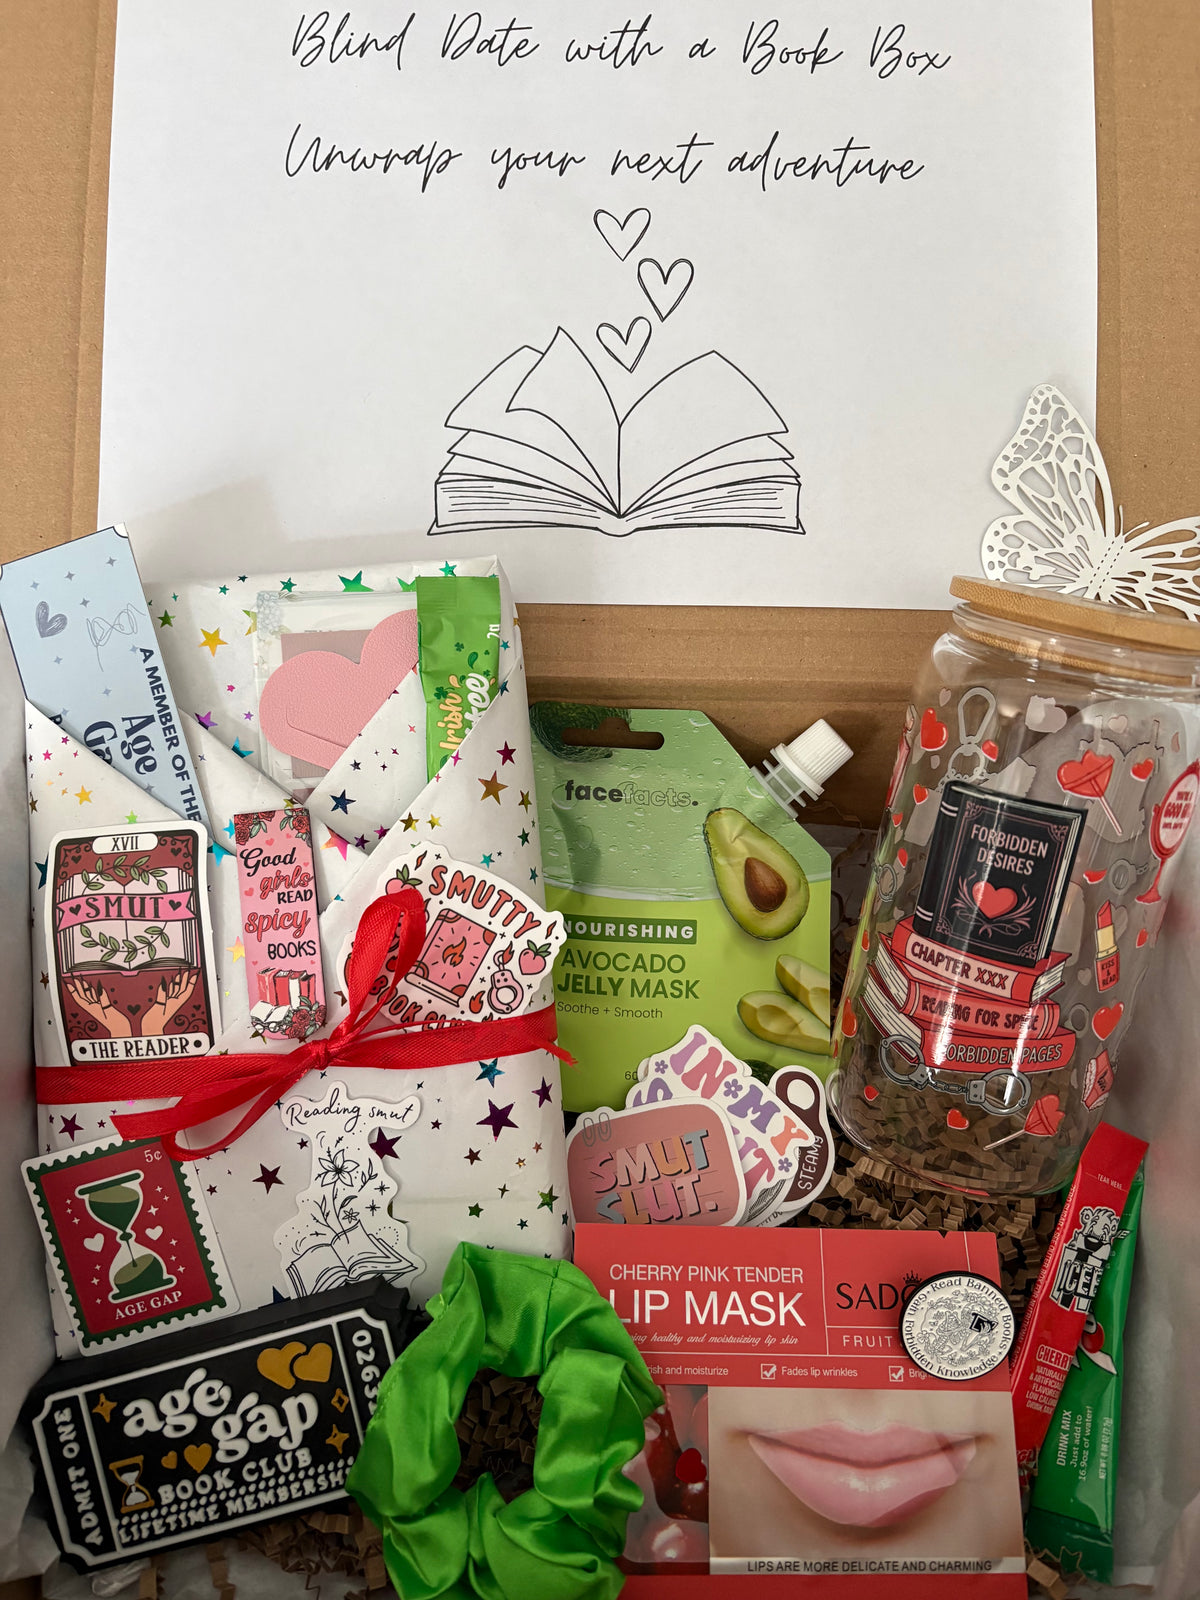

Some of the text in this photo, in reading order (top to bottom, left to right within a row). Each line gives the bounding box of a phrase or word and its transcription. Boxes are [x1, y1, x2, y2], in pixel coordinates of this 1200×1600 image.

[291, 11, 952, 79] Blind Date with a Book Box
[284, 123, 926, 193] Unwrap your next adventure
[121, 713, 158, 775] Age
[139, 647, 202, 821] A MEMBER OF THE
[111, 835, 139, 851] XVII
[970, 823, 1049, 859] FORBIDDEN
[239, 846, 297, 878] Good
[976, 847, 1035, 876] DESIRES
[259, 865, 314, 900] girls
[277, 888, 313, 905] READ
[85, 895, 164, 919] SMUT
[428, 864, 542, 939] SMUTTY
[563, 919, 695, 940] NOURISHING
[267, 939, 317, 961] BOOKS
[560, 948, 686, 974] AVOCADO
[910, 941, 1010, 990] CHAPTER XXX
[368, 974, 424, 1023] BOOK
[557, 972, 701, 1000] JELLY MASK
[557, 1001, 600, 1015] Soothe
[614, 1006, 663, 1019] Smooth
[974, 1008, 1001, 1027] FOR
[89, 1036, 190, 1060] THE READER
[944, 1043, 1063, 1064] ORBIDDEN PAGES
[285, 1087, 415, 1133] Reading smut
[669, 1031, 738, 1100] IN
[727, 1083, 810, 1157] MY
[143, 1148, 163, 1164] 5¢
[590, 1128, 710, 1194] SMUT
[609, 1263, 804, 1284] CHERRY PINK TENDER
[114, 1289, 183, 1321] AGE GAP
[609, 1288, 807, 1328] LIP MASK
[930, 1277, 1012, 1351] Read Banned Books
[650, 1332, 684, 1346] healthy
[687, 1332, 707, 1344] and
[708, 1334, 762, 1347] moisturizing
[764, 1336, 777, 1347] lip
[780, 1334, 799, 1346] skin
[842, 1334, 893, 1348] FRUIT
[904, 1292, 1000, 1378] Gain Forbidden Knowledge
[665, 1365, 682, 1376] and
[684, 1365, 729, 1377] moisturize
[781, 1366, 858, 1380] Fades lip wrinkles
[122, 1367, 233, 1440] age
[210, 1391, 320, 1464] gap
[1056, 1409, 1072, 1467] DRINK MIX
[1069, 1414, 1083, 1468] Just add to
[1083, 1437, 1090, 1449] of
[53, 1406, 104, 1547] ADMIT ONE
[157, 1446, 313, 1506] BOOK CLUB
[118, 1467, 350, 1544] LIFETIME MEMBERSH
[747, 1560, 993, 1573] LIPS ARE MORE DELICATE AND CHARMING
